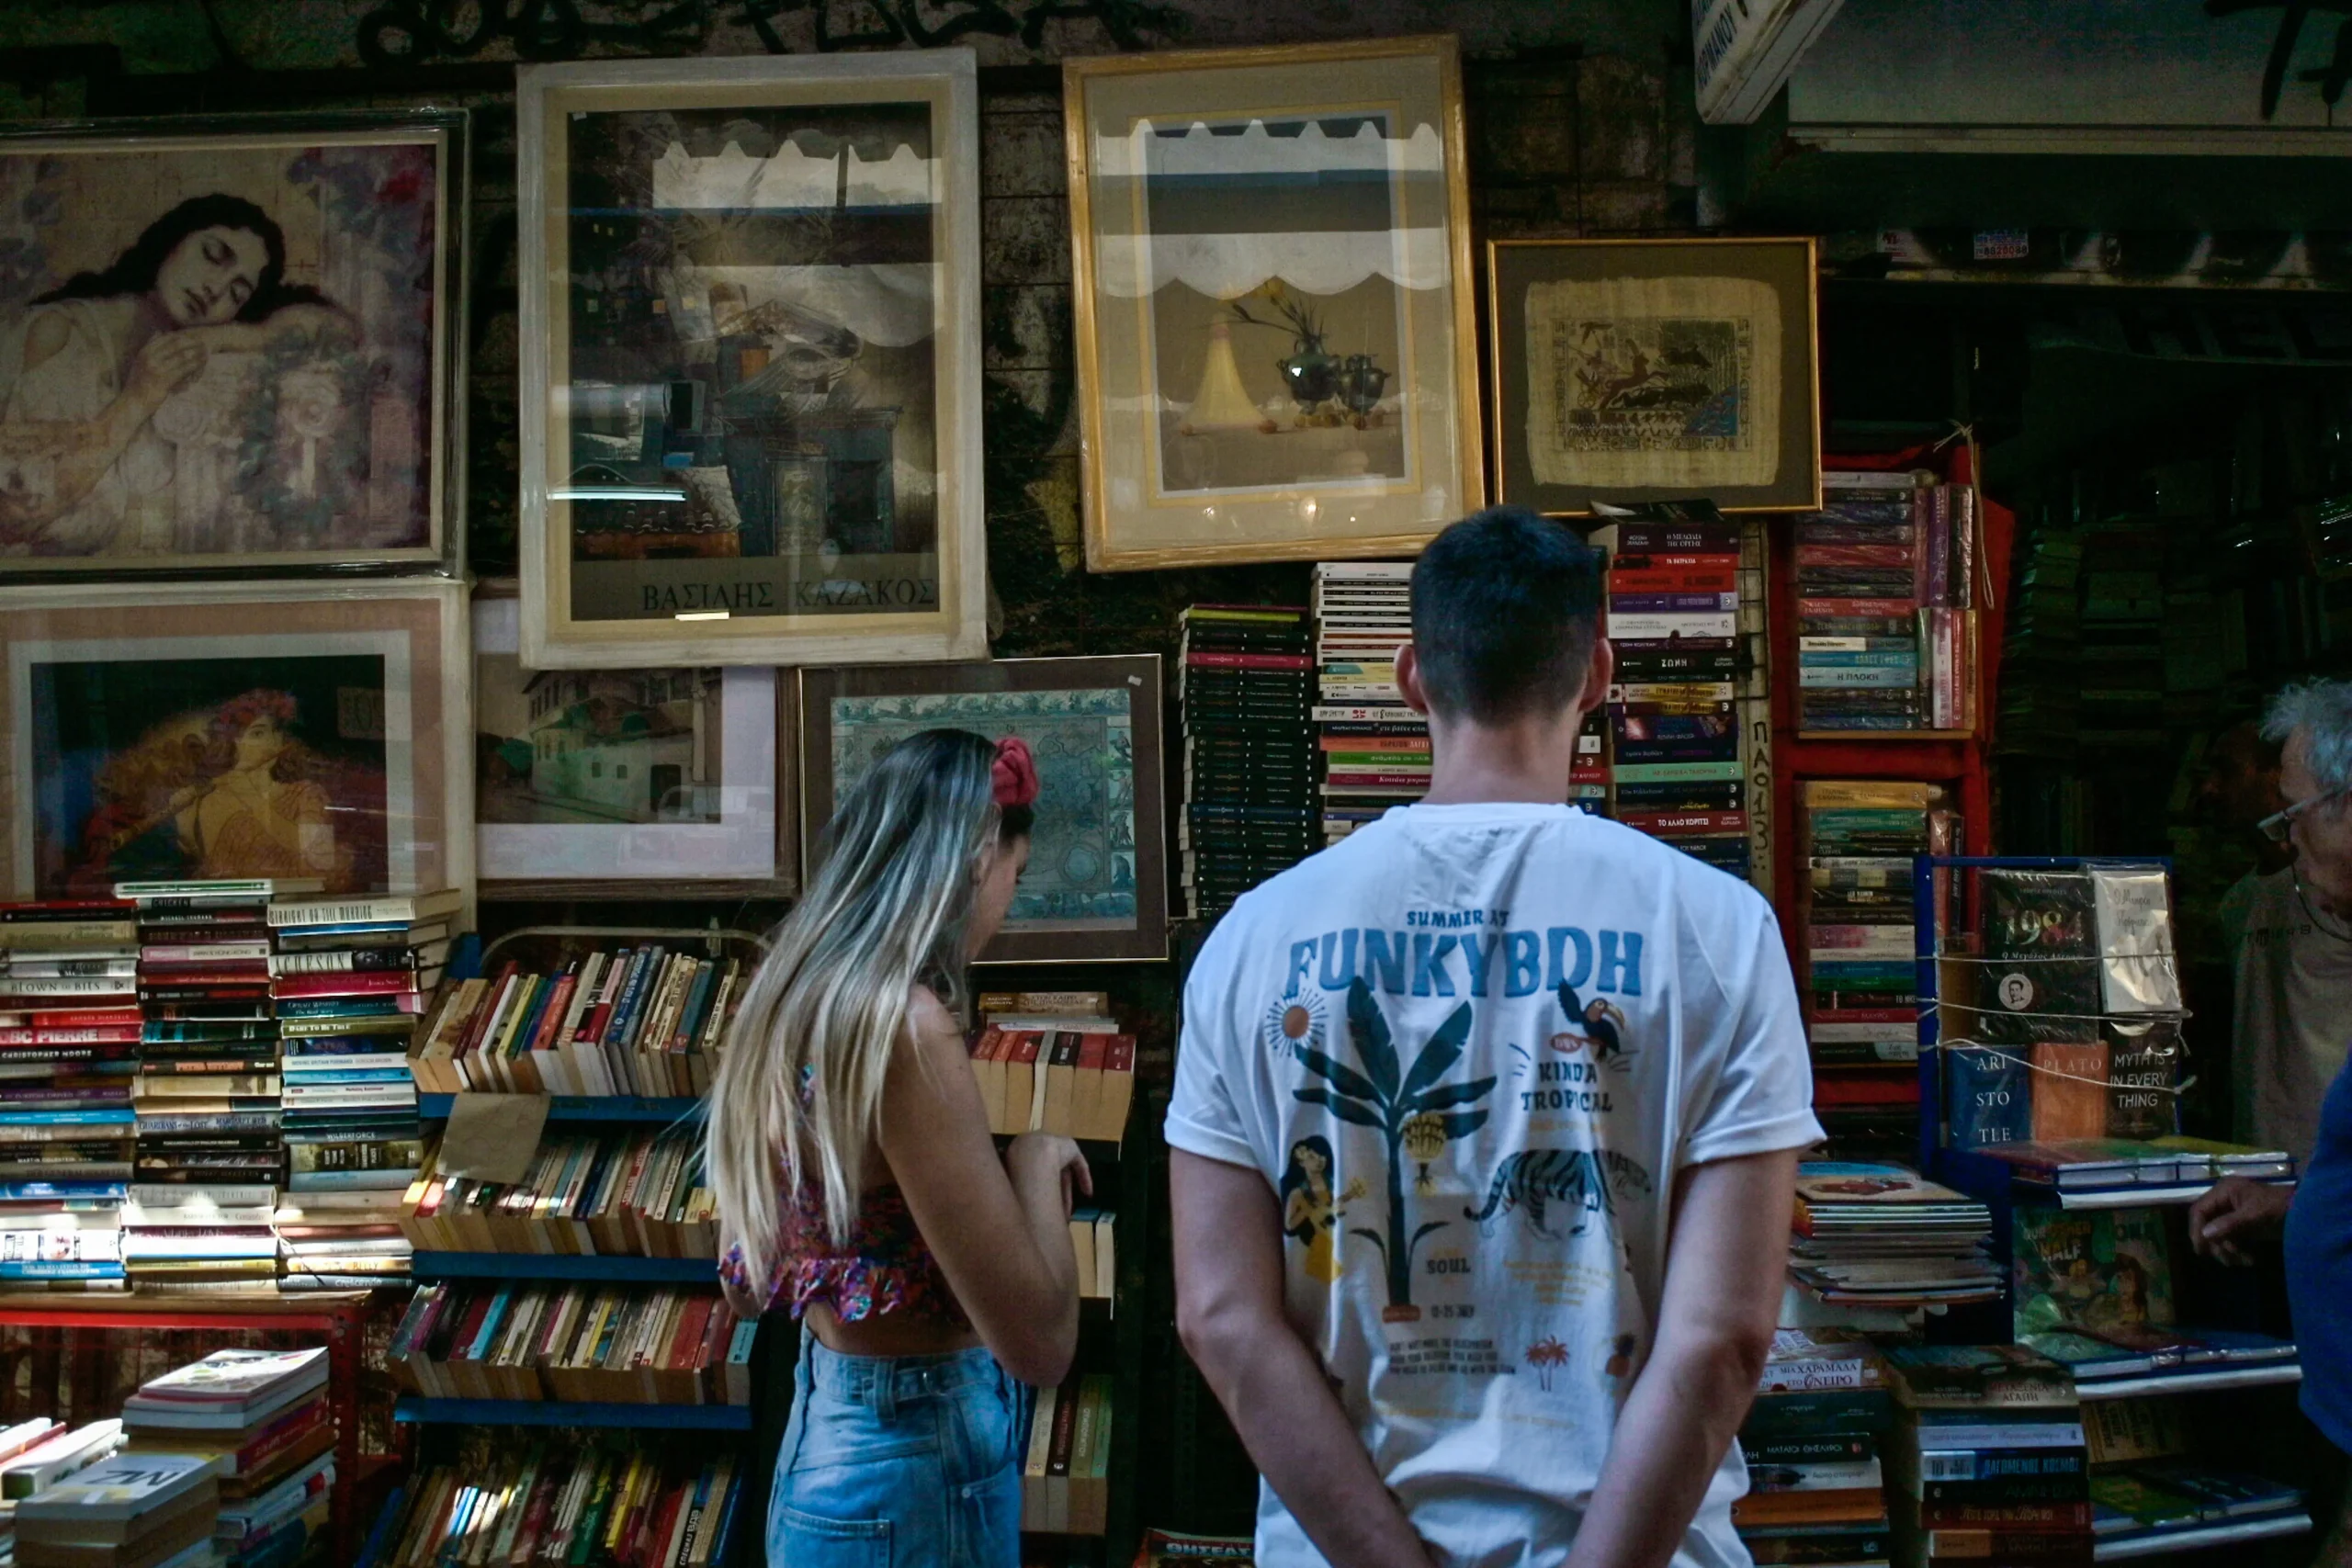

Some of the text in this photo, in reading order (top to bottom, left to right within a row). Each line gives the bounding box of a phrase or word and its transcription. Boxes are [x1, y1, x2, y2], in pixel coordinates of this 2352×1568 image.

[642, 579, 935, 611] ΒΑΣΙΛΗΣ ΚΑΖΑΚΟΣ
[1846, 673, 1879, 682] ΠΛΟΚΗ
[1685, 818, 1710, 826] ΚΟΡΙΤΣΙ
[269, 909, 306, 925] STRAIGHT
[1408, 909, 1510, 928] SUMMER AT
[2005, 908, 2085, 946] 1984
[275, 953, 345, 976] ACHESON
[1283, 926, 1644, 999] FUNKYBDH
[11, 982, 57, 993] BLOWN
[37, 1028, 98, 1043] PIERRE
[1976, 1056, 2007, 1071] ARI
[2042, 1058, 2102, 1073] PLATO
[1538, 1061, 1598, 1084] KINDA
[2127, 1072, 2168, 1088] EVERY
[1521, 1089, 1613, 1112] TROPICAL
[1975, 1090, 2010, 1106] STO
[2117, 1092, 2158, 1109] THING
[326, 1132, 376, 1141] WILBERFORCE
[1978, 1127, 2011, 1143] TLE
[1426, 1257, 1471, 1276] SOUL
[1796, 1362, 1857, 1374] ΧΑΡΑΜΑΔΑ
[2002, 1393, 2039, 1402] ΑΓΑΠΗ
